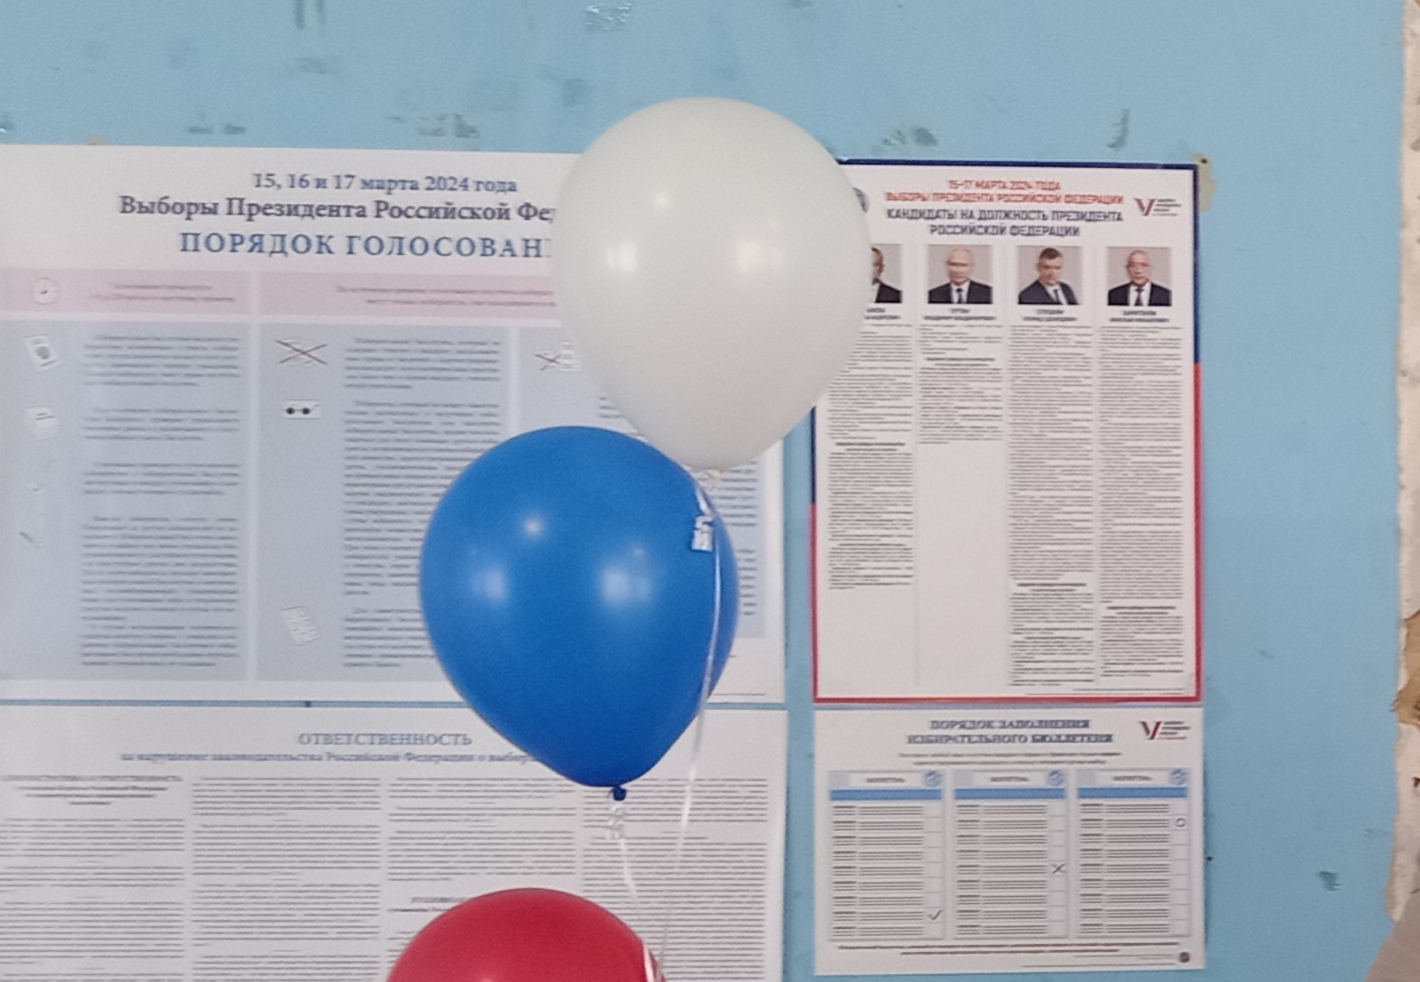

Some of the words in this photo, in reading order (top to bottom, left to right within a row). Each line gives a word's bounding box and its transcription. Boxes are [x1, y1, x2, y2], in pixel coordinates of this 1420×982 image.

[253, 173, 282, 190] 15,
[288, 174, 310, 189] 16
[314, 177, 327, 190] и
[334, 174, 355, 190] 17
[360, 178, 419, 195] марта
[424, 176, 470, 192] 2024
[474, 179, 518, 195] года
[975, 179, 1006, 190] МАРТА
[886, 191, 929, 202] ВЫБОРЫ
[932, 192, 994, 203] ПРЕЗИДЕНТА
[997, 193, 1062, 203] РОССИЙСКОЙ
[1064, 194, 1124, 205] ФЕДЕРАЦИИ
[118, 195, 219, 220] Выборы
[225, 196, 368, 222] Президента
[373, 199, 511, 221] Российской
[887, 208, 957, 220] КАНДИДАТЫ
[960, 209, 975, 220] НА
[978, 209, 1049, 221] ДОЛЖНОСТЬ
[1051, 210, 1123, 222] ПРЕЗИДЕНТА
[929, 222, 1007, 236] РОССИЙСКОЙ
[1009, 224, 1080, 237] ФЕДЕРАЦИИ
[179, 232, 335, 258] ПОРЯДОК
[930, 719, 994, 730] ПОРЯДОК
[298, 732, 473, 746] ОТВЕТСТВЕННОСТЬ
[906, 734, 1028, 745] ИЗБИРАТЕЛЬНОГО
